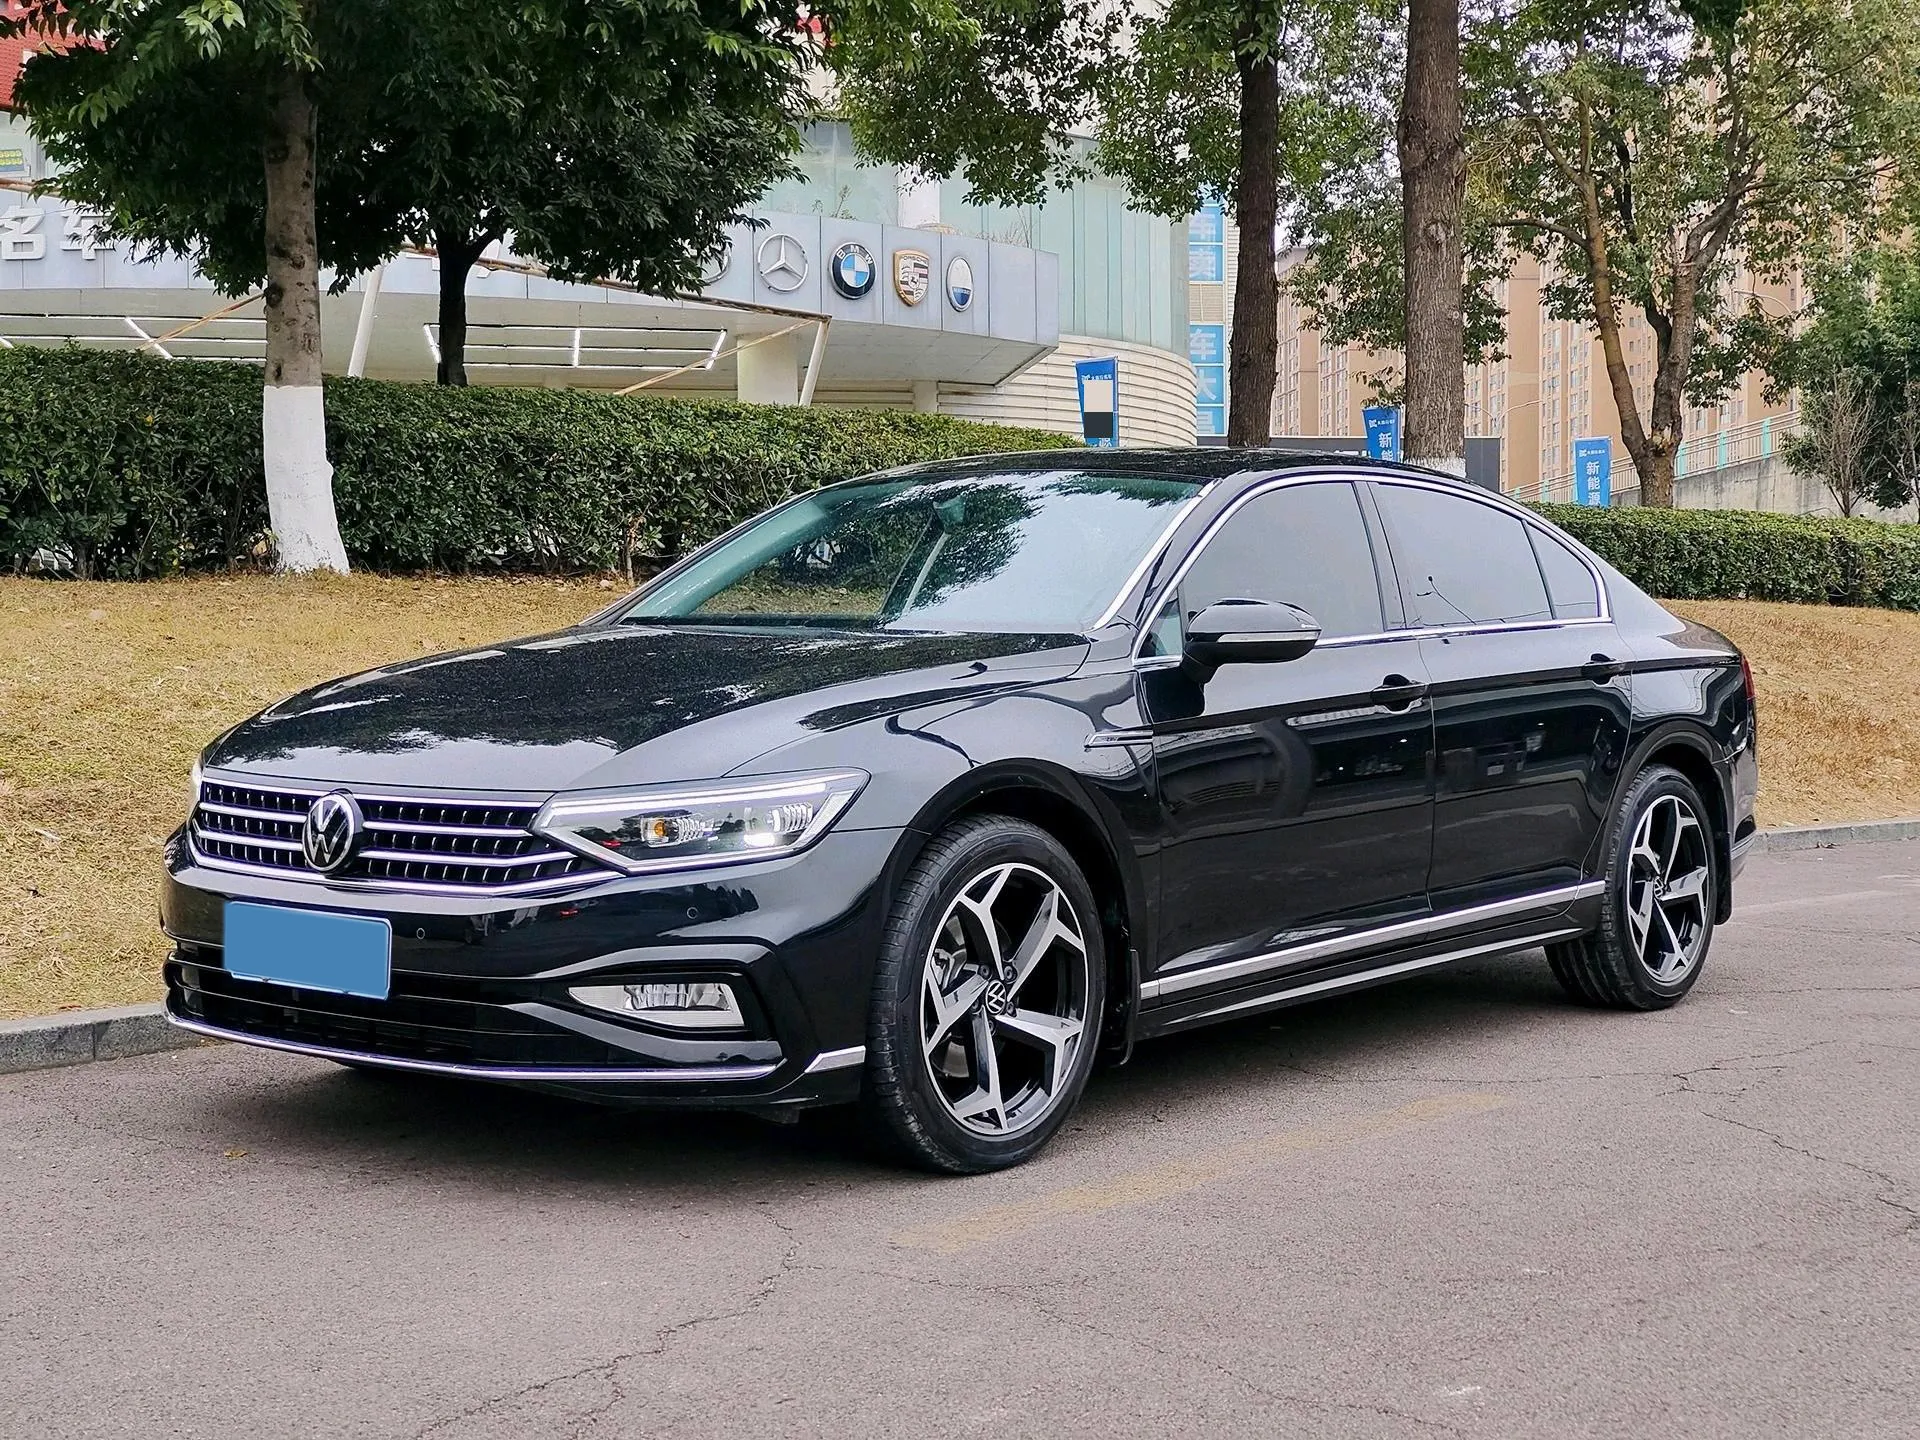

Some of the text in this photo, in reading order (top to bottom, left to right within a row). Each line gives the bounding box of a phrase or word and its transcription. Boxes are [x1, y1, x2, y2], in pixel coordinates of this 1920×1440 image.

[836, 245, 874, 264] BMW
[1586, 461, 1601, 506] 新能源
